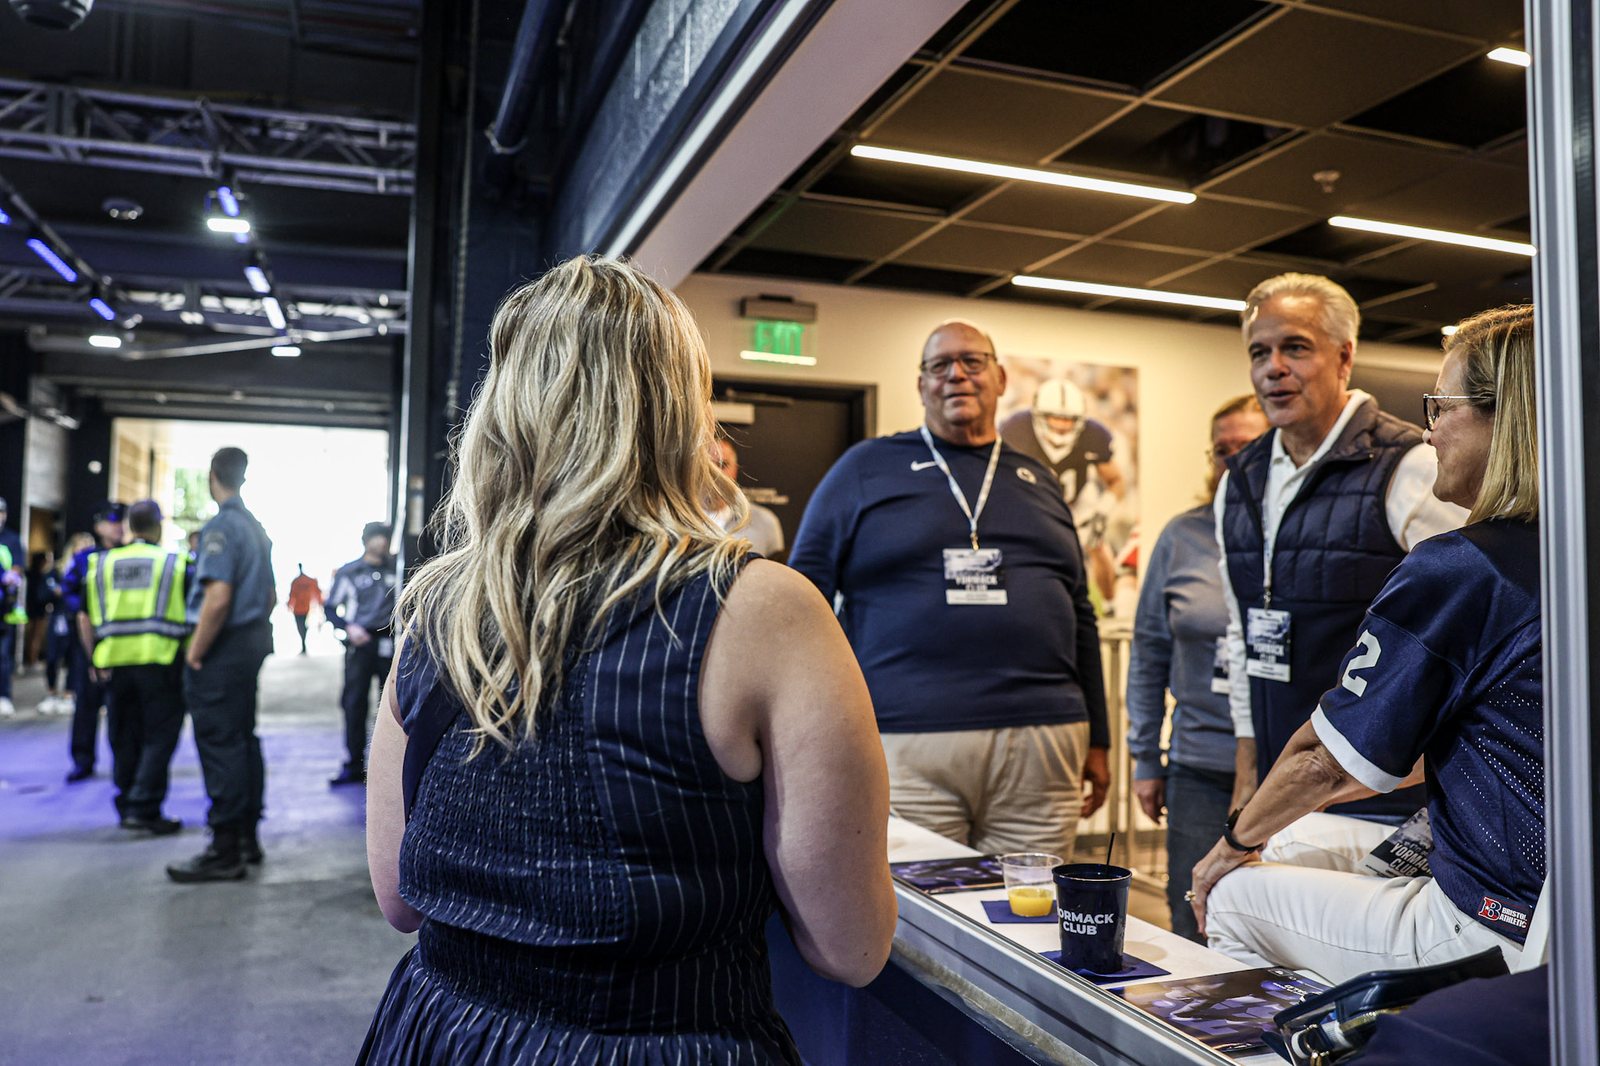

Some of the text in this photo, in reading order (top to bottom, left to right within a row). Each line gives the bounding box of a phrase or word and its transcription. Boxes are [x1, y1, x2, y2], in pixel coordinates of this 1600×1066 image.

[1342, 629, 1381, 697] 2
[1390, 858, 1418, 876] CLUB
[1058, 908, 1114, 924] ORMACK
[1499, 914, 1527, 928] ATHLETIC
[1502, 907, 1527, 921] BRISTOL
[1063, 921, 1097, 935] CLUB
